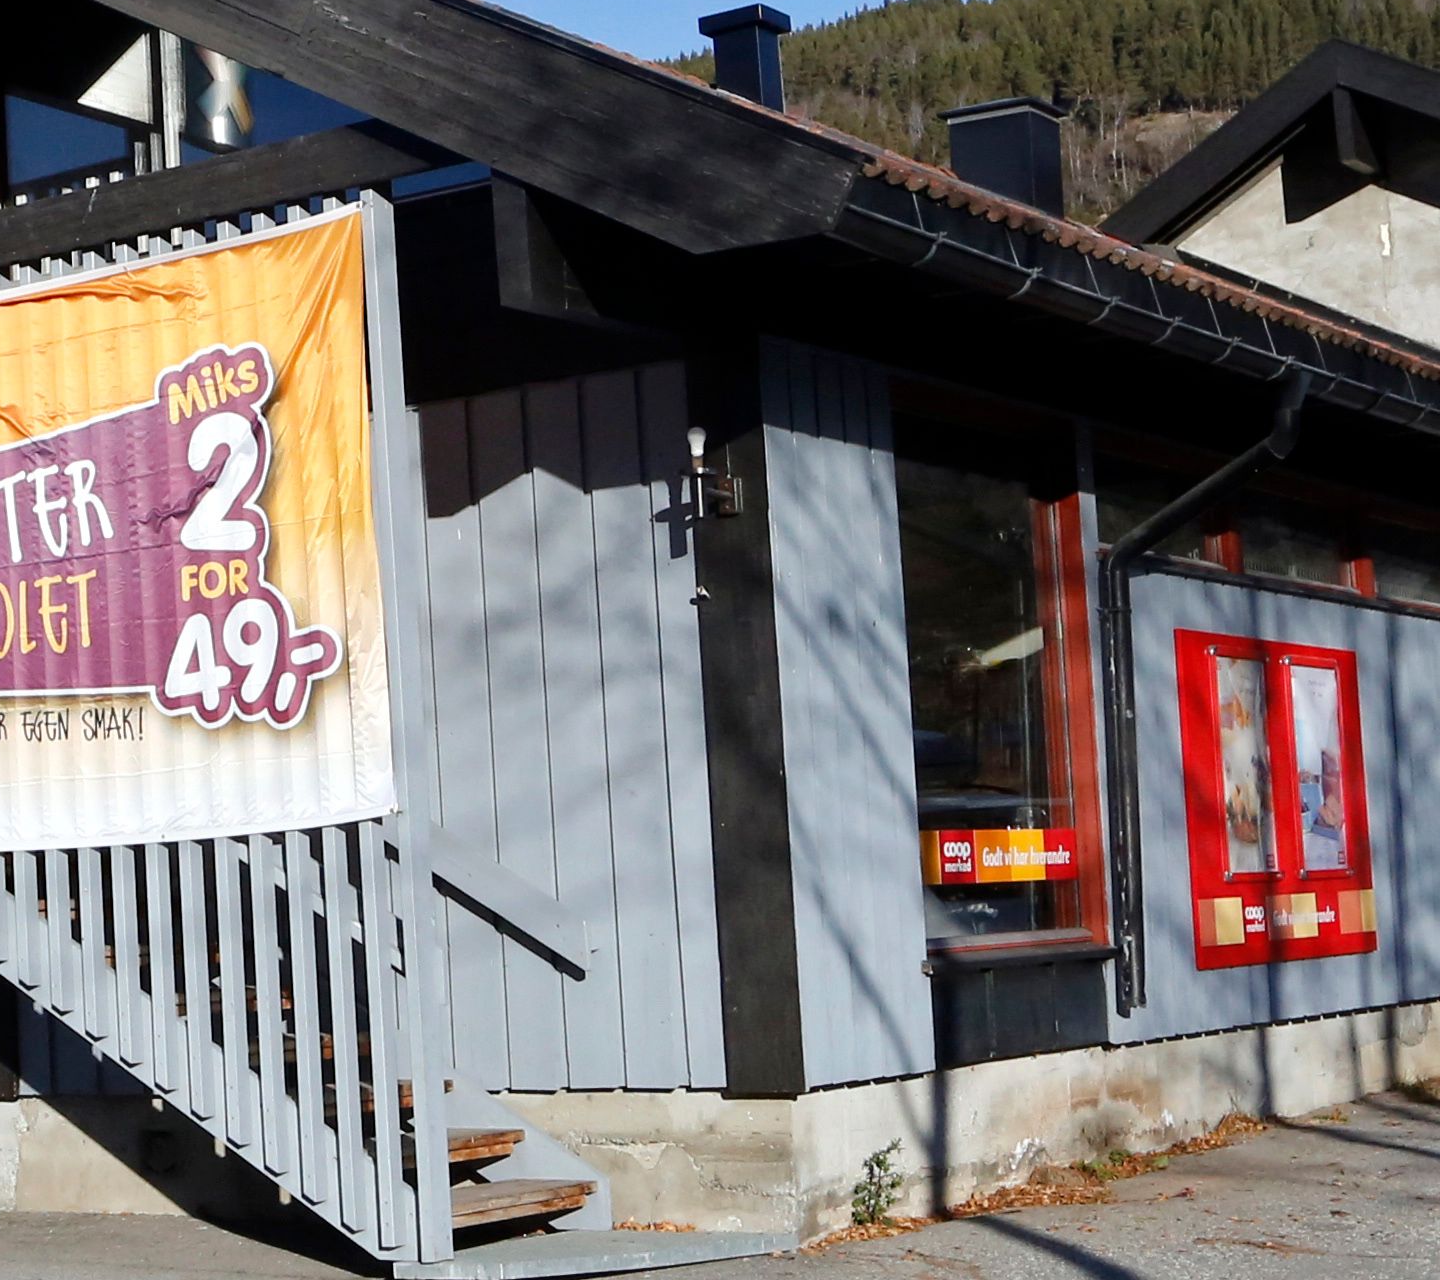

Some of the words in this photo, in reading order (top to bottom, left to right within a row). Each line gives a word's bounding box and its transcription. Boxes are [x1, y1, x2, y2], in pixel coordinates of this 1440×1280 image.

[179, 411, 259, 552] 2
[180, 558, 250, 602] FOR
[21, 707, 71, 742] EGEN
[81, 706, 145, 742] SMAK!
[943, 841, 971, 861] coop
[982, 845, 1004, 867] Godt
[1004, 847, 1013, 866] vi
[1013, 847, 1029, 866] har
[1030, 844, 1071, 866] hverandre
[944, 858, 972, 873] marked
[1245, 905, 1265, 921] coop
